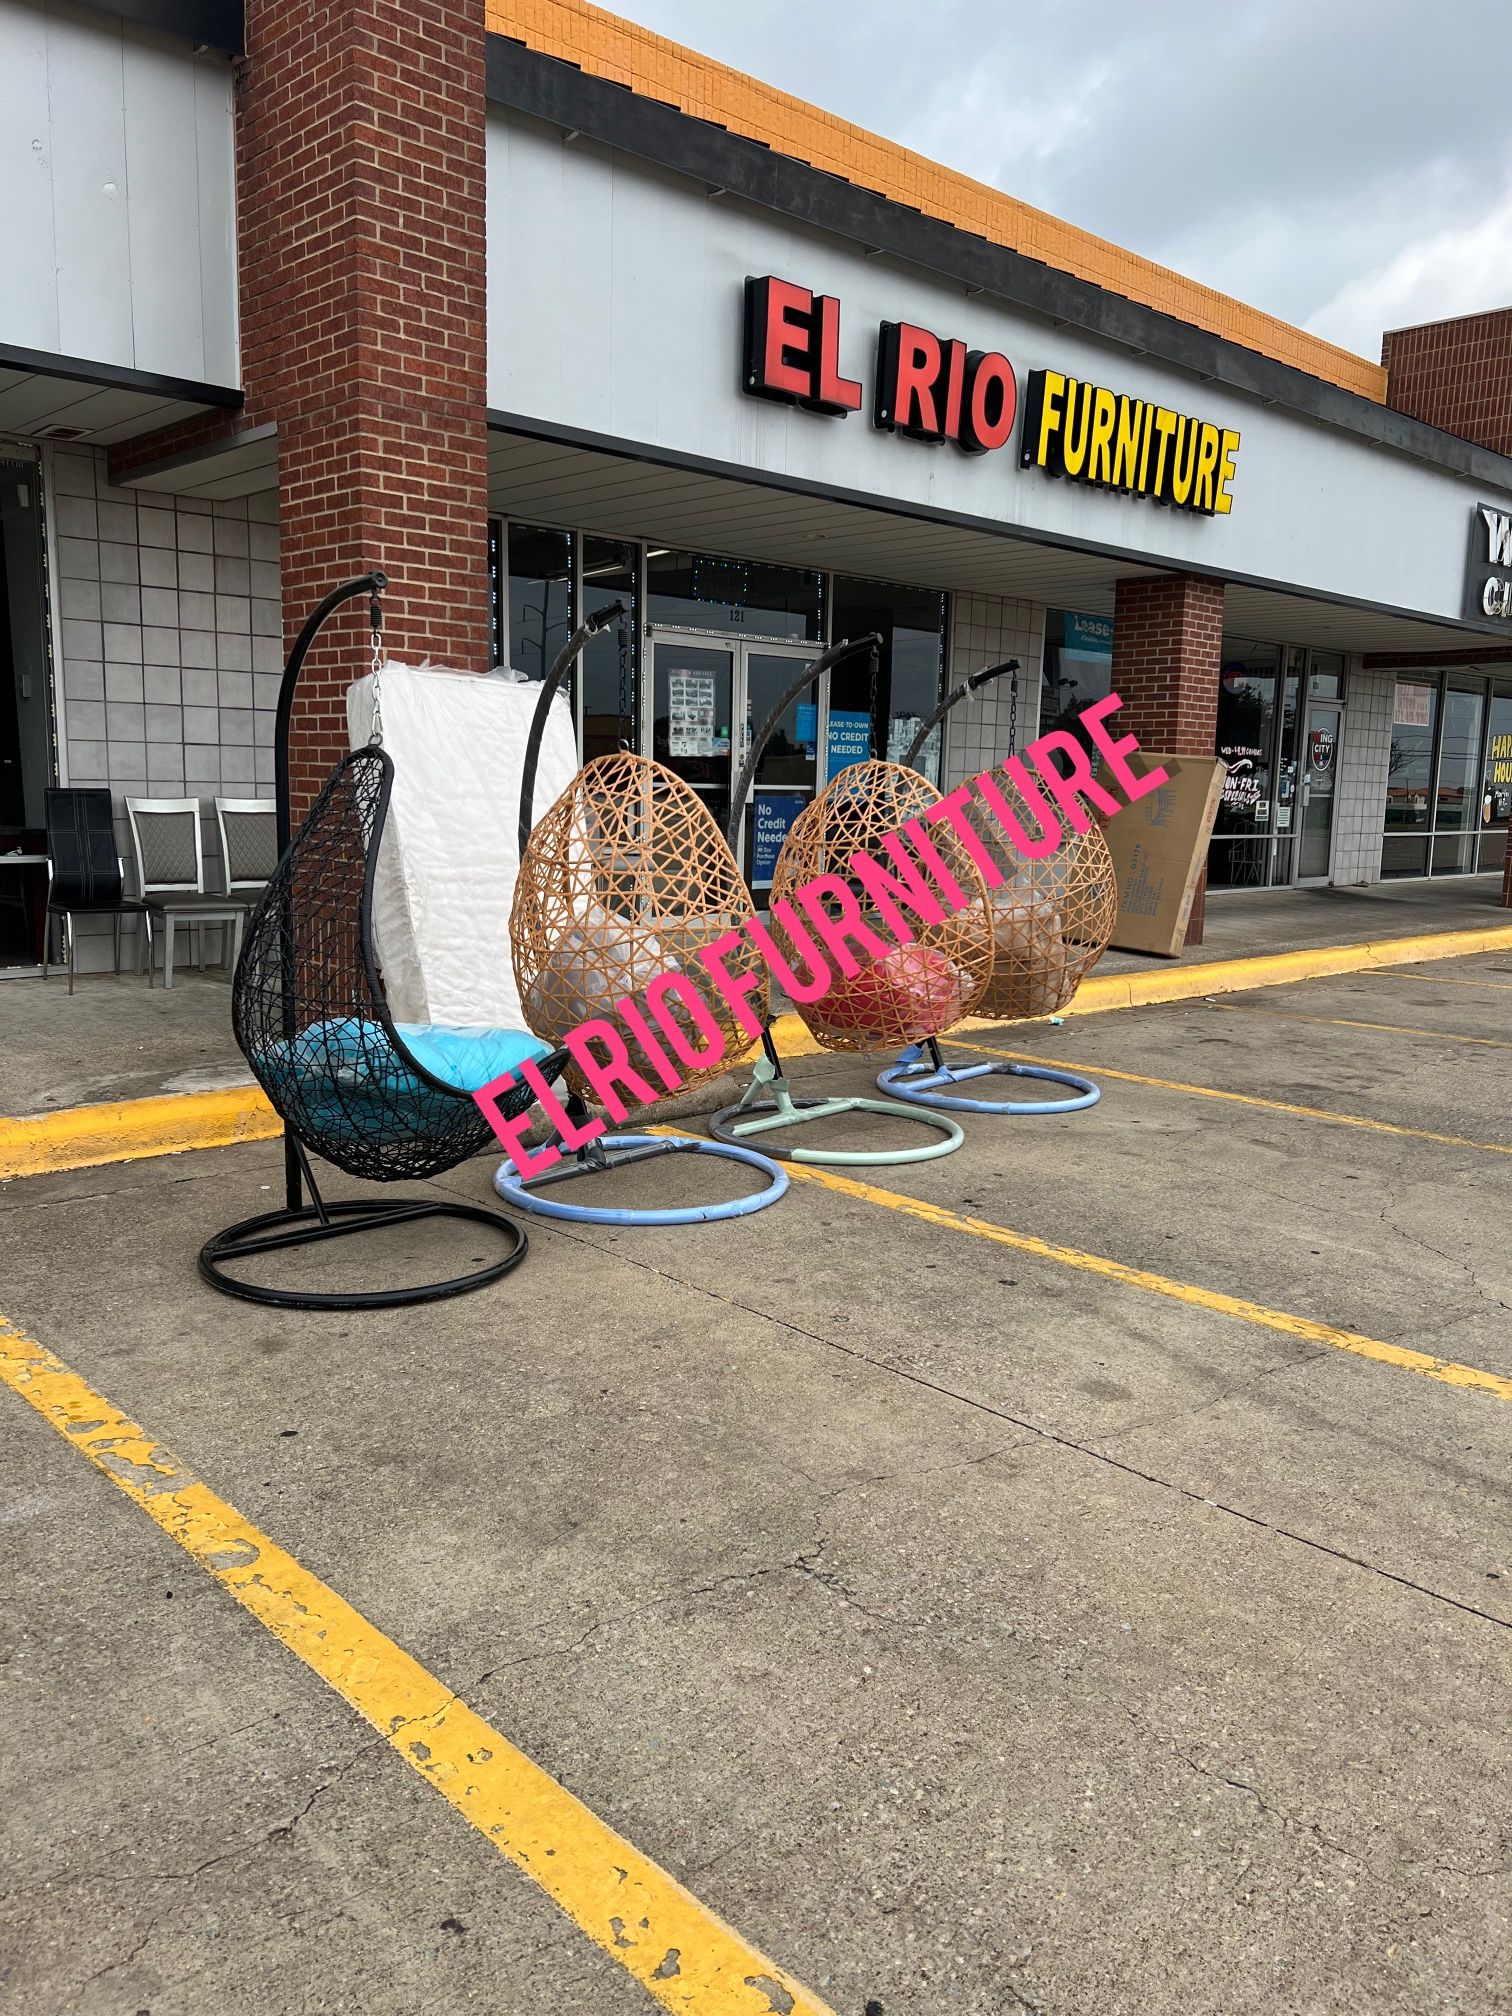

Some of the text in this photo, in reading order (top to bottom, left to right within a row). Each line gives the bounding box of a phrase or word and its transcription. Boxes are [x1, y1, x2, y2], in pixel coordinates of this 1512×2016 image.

[758, 275, 1241, 516] EL RIO FURNITURE
[729, 610, 745, 623] 121
[829, 720, 869, 730] EASE-TO-OWN
[840, 732, 869, 742] CREDIT
[830, 745, 863, 755] NEEDED
[1314, 744, 1331, 754] CITY
[1224, 776, 1260, 792] ON-FRI
[758, 804, 772, 815] No
[757, 818, 786, 830] Credit
[757, 831, 787, 843] Neede
